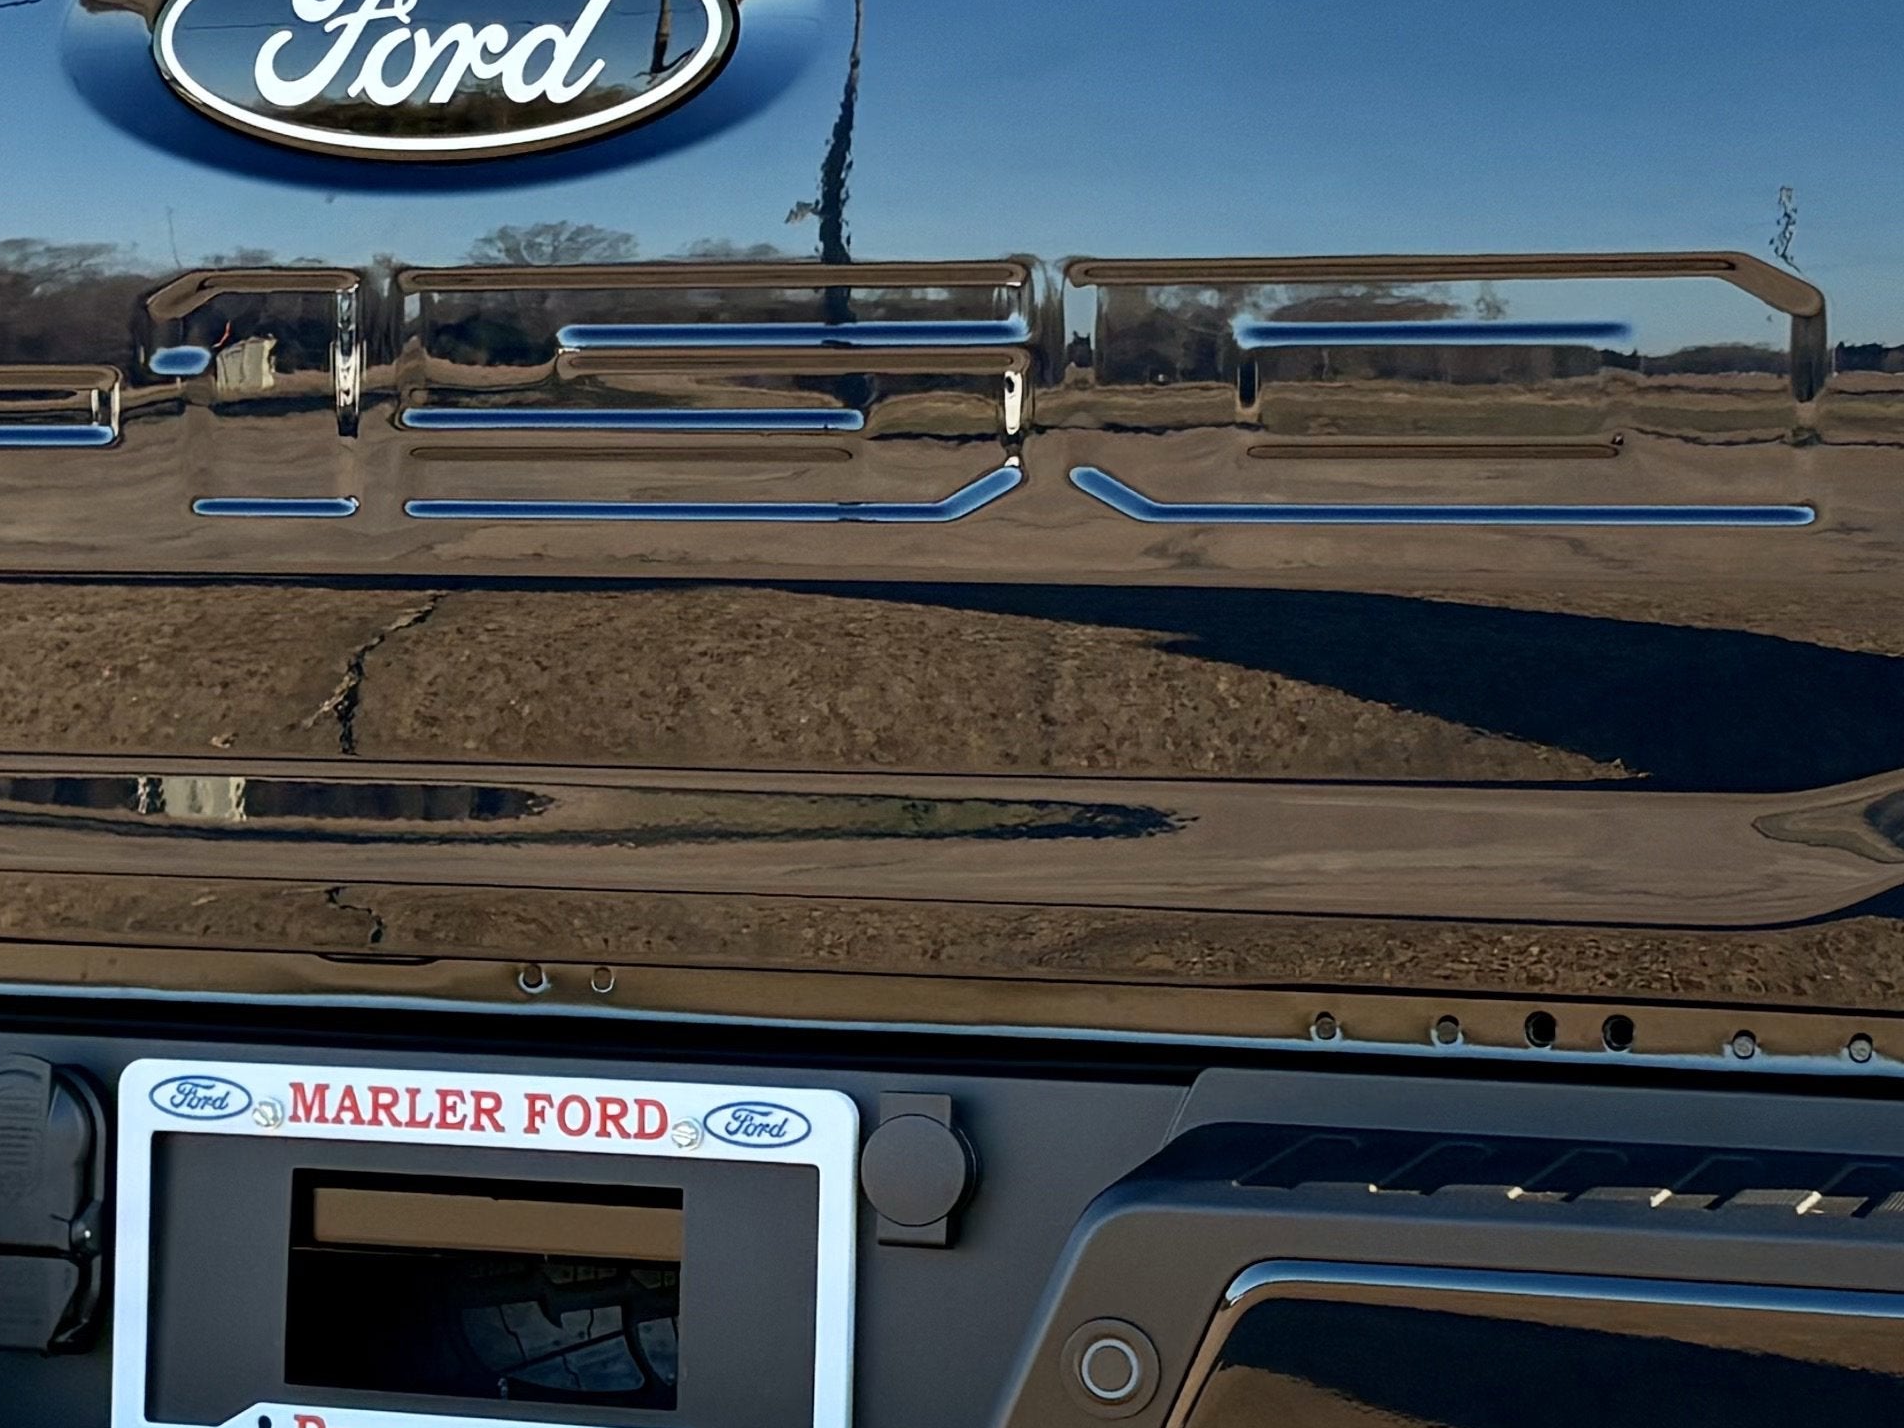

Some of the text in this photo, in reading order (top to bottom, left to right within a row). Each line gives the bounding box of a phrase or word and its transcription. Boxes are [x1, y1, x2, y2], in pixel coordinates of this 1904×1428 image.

[170, 1081, 229, 1111] Ford
[288, 1082, 669, 1141] MARLER FORD
[724, 1107, 789, 1139] Ford
